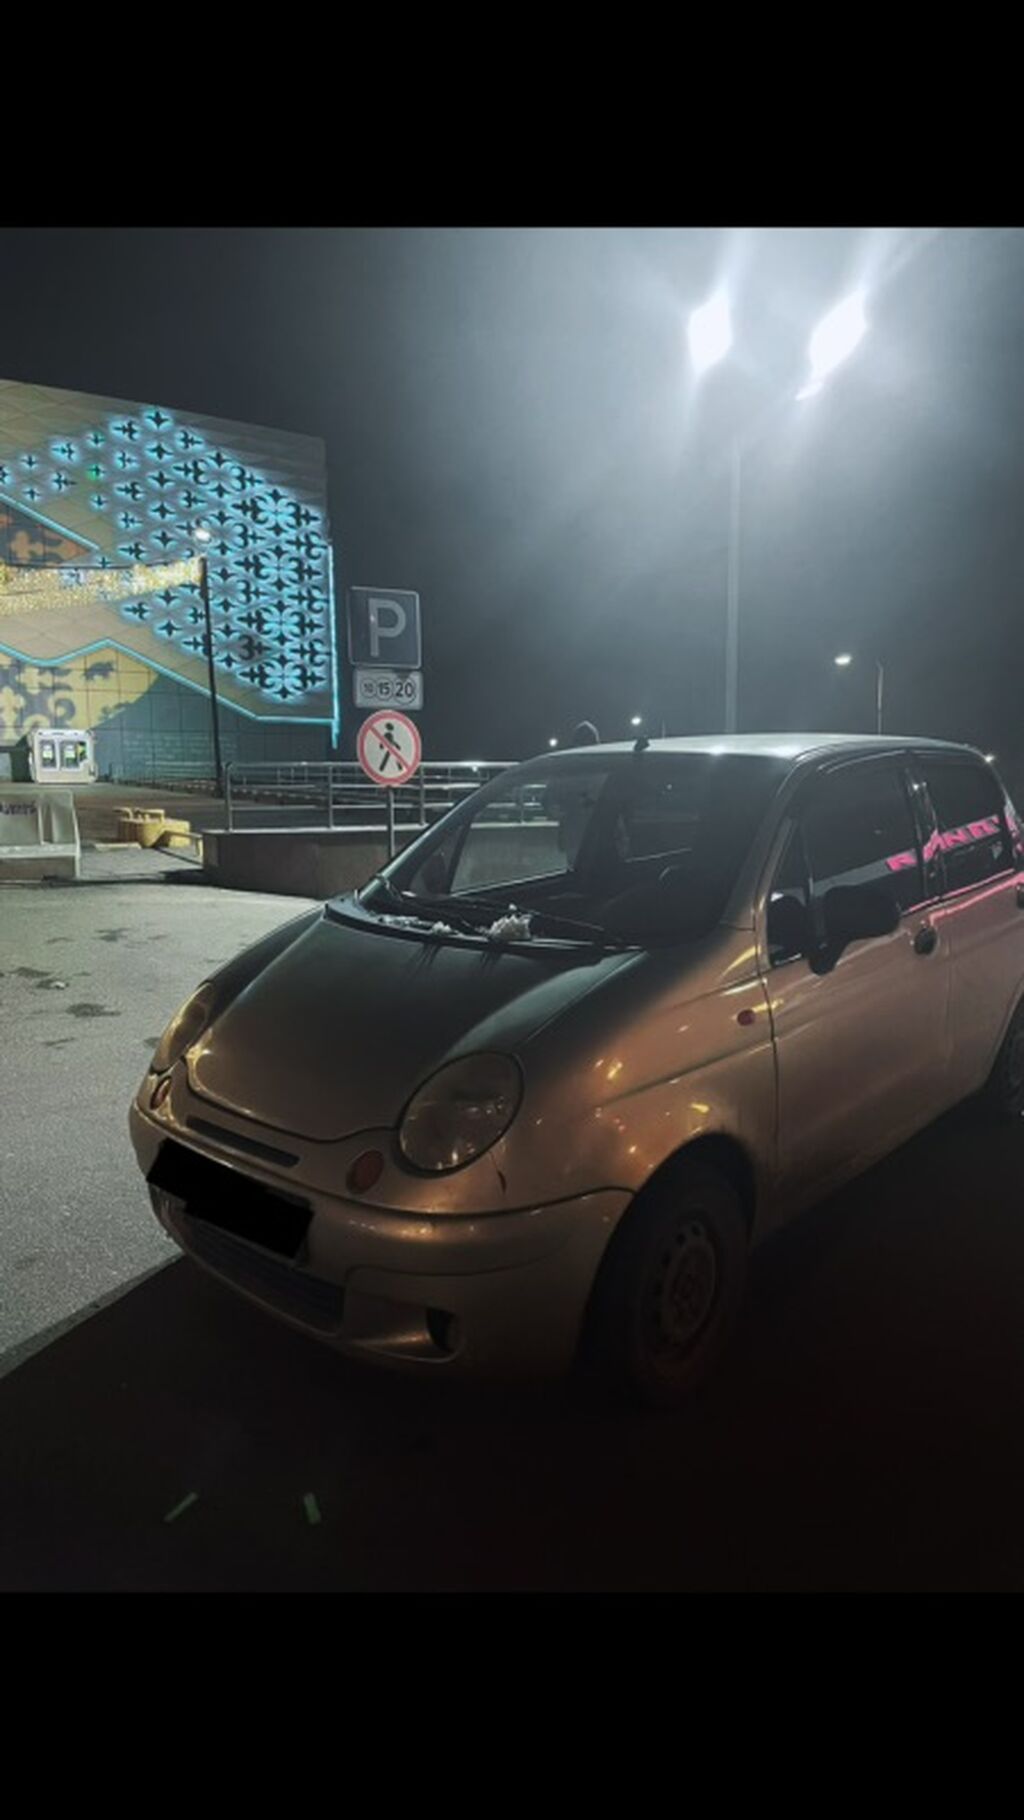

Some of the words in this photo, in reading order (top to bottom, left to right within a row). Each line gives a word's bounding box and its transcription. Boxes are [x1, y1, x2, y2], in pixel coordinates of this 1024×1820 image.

[368, 597, 407, 658] P
[377, 681, 391, 696] 15
[395, 681, 414, 698] 20
